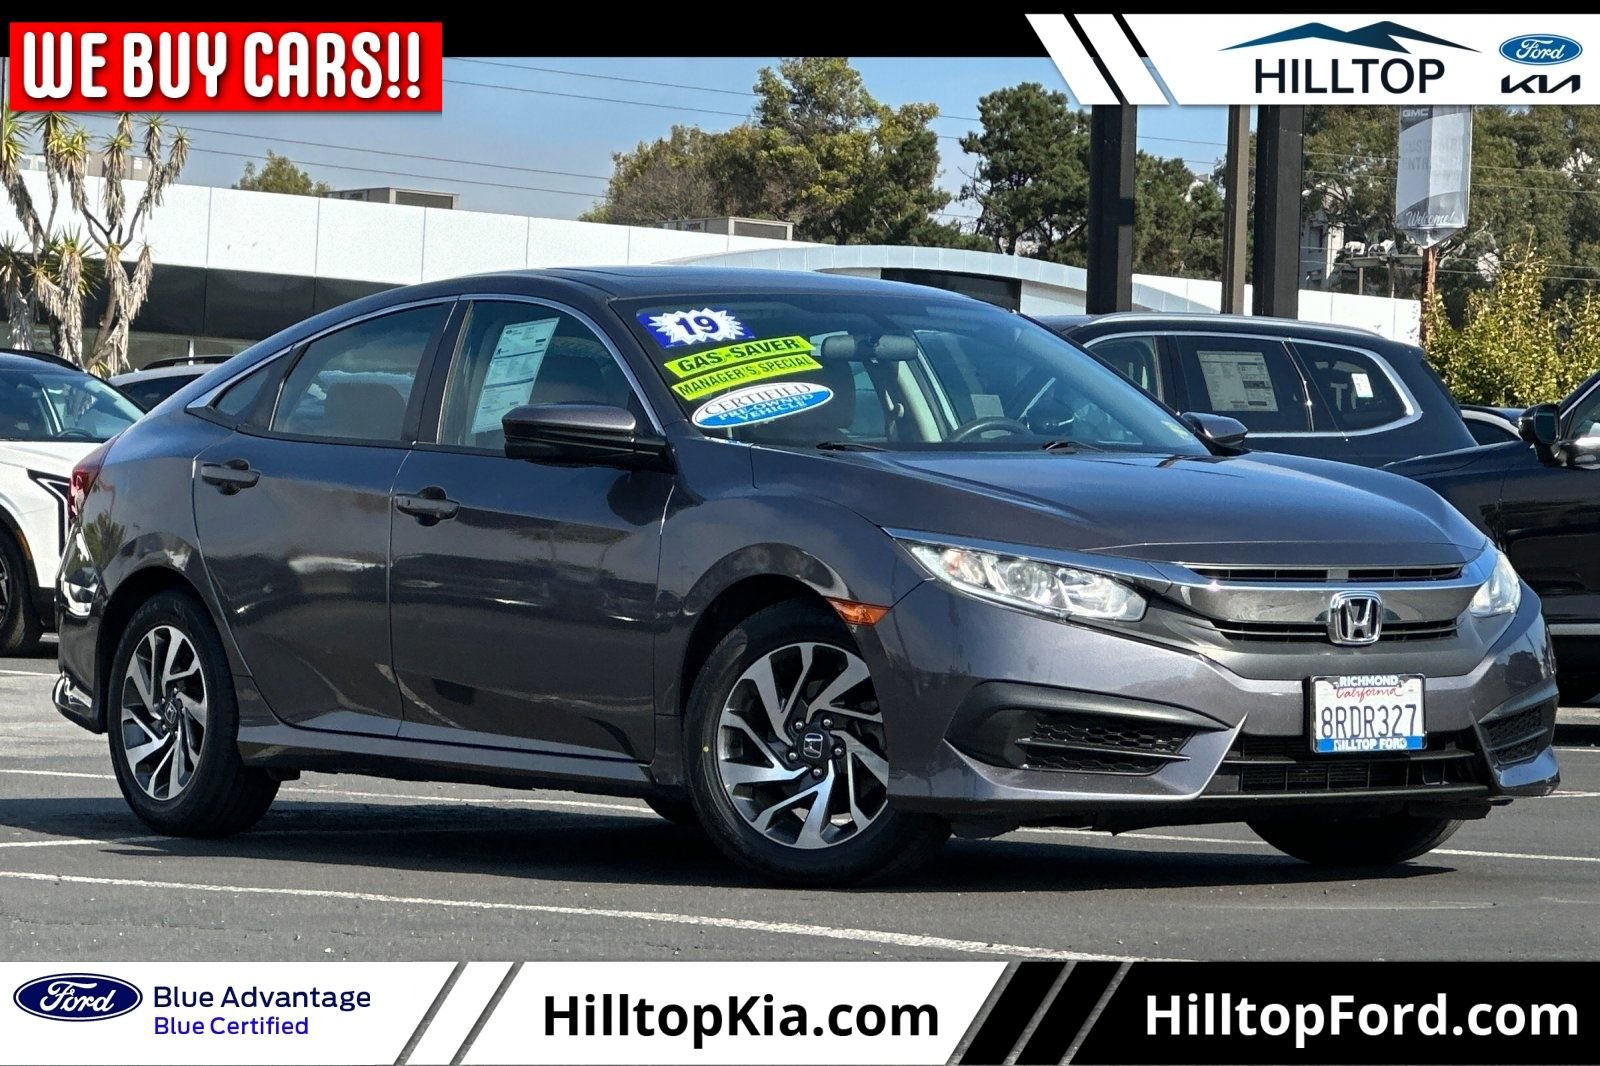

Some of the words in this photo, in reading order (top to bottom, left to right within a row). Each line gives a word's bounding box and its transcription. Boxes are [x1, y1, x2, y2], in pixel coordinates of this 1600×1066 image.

[1402, 108, 1429, 117] GMC
[675, 316, 720, 336] 19
[678, 365, 757, 395] MANAGER'S
[758, 356, 813, 373] SPECIAL
[705, 384, 811, 415] CERTIFIED
[718, 393, 814, 420] PRE-OWNED
[738, 401, 807, 420] VEHICLE
[1339, 675, 1399, 687] RICHMOND
[1336, 687, 1403, 703] California
[1321, 704, 1417, 739] 8RDR327
[1333, 738, 1377, 751] HILLTOP
[1379, 737, 1408, 750] FORD
